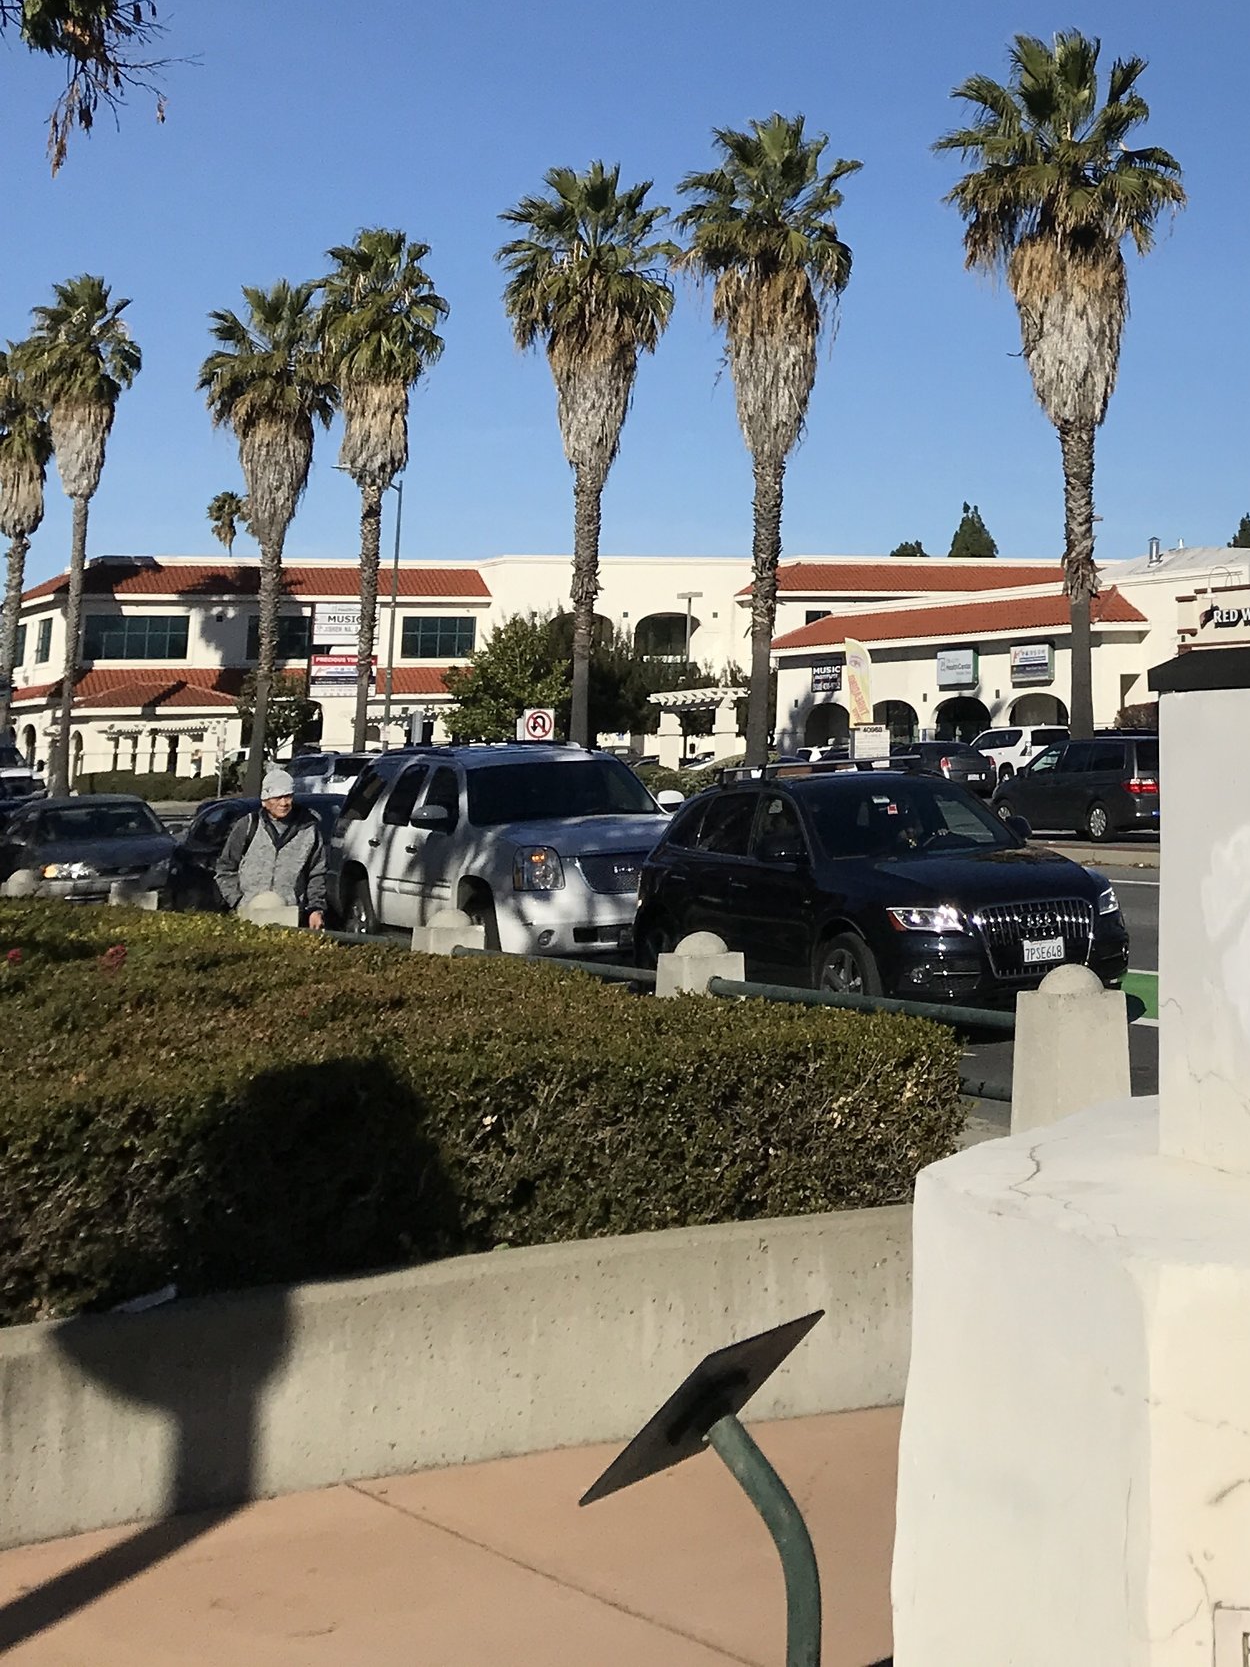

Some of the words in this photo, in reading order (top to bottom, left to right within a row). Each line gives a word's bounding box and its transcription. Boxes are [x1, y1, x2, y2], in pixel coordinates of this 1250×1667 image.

[1213, 609, 1239, 623] RED
[813, 666, 841, 675] MUSIC
[1025, 945, 1063, 961] 7PSE648
